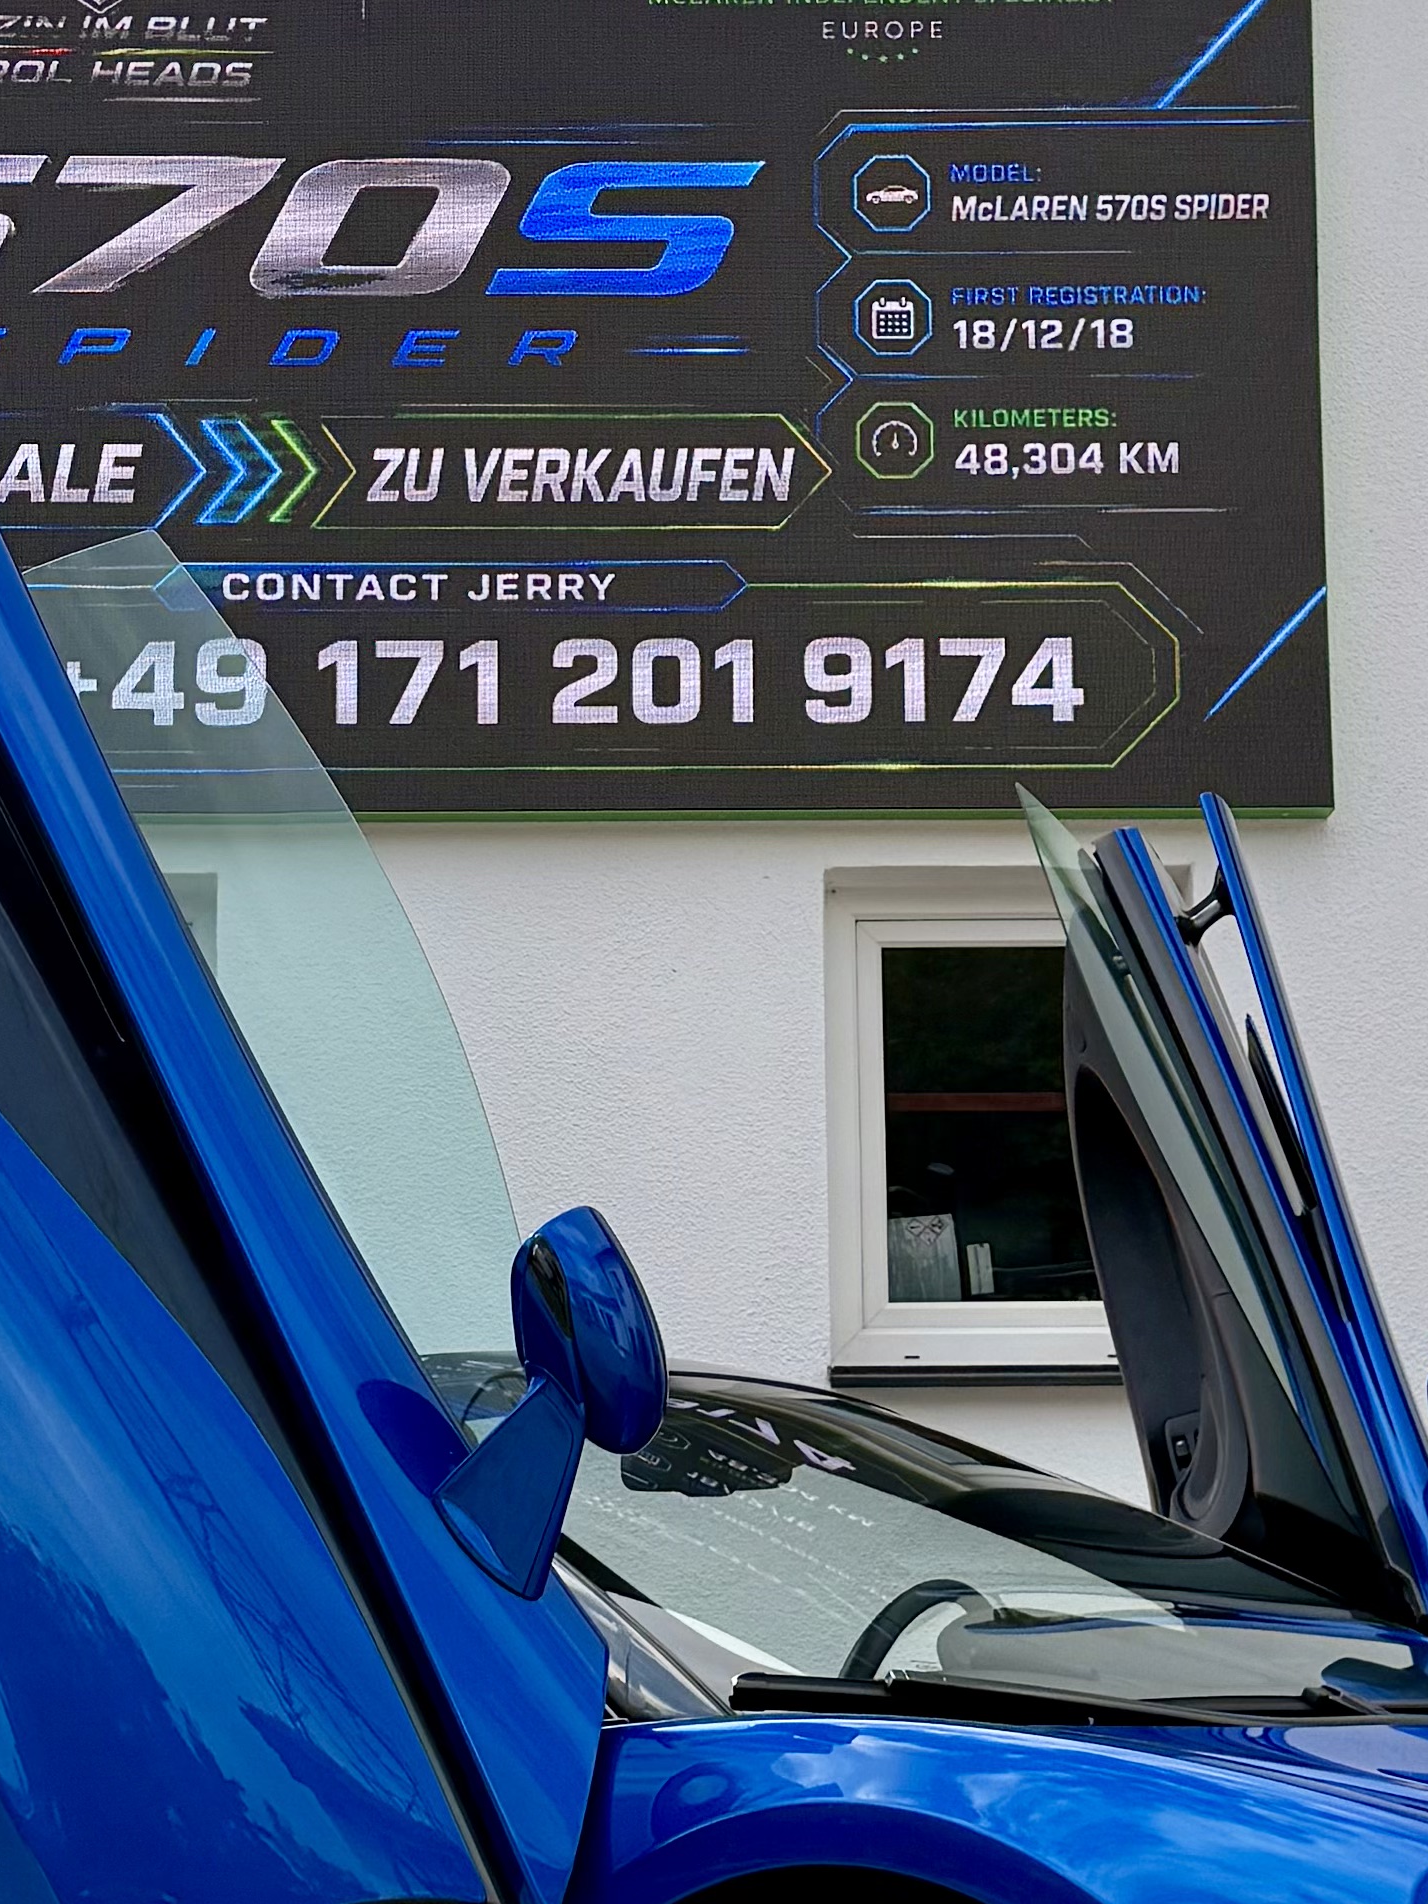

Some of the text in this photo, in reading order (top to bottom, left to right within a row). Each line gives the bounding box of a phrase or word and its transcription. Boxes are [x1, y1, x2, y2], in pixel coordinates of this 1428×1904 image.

[79, 14, 133, 39] IM
[144, 16, 269, 41] BLUT
[822, 20, 946, 40] EUROPE
[91, 60, 254, 87] HEADS
[950, 163, 1042, 183] MODEL:
[951, 193, 1271, 223] McLAREN 570S SPIDER
[952, 285, 1207, 305] FIRST REGISTRATION:
[952, 317, 1135, 352] 18/12/18
[954, 407, 1118, 428] KILOMETERS:
[954, 442, 1180, 479] 48,304 KM
[366, 447, 796, 503] ZU VERKAUFEN
[222, 572, 617, 602] CONTACT JERRY
[317, 639, 500, 726] 171
[552, 637, 755, 725] 201
[803, 636, 1086, 725] 9174
